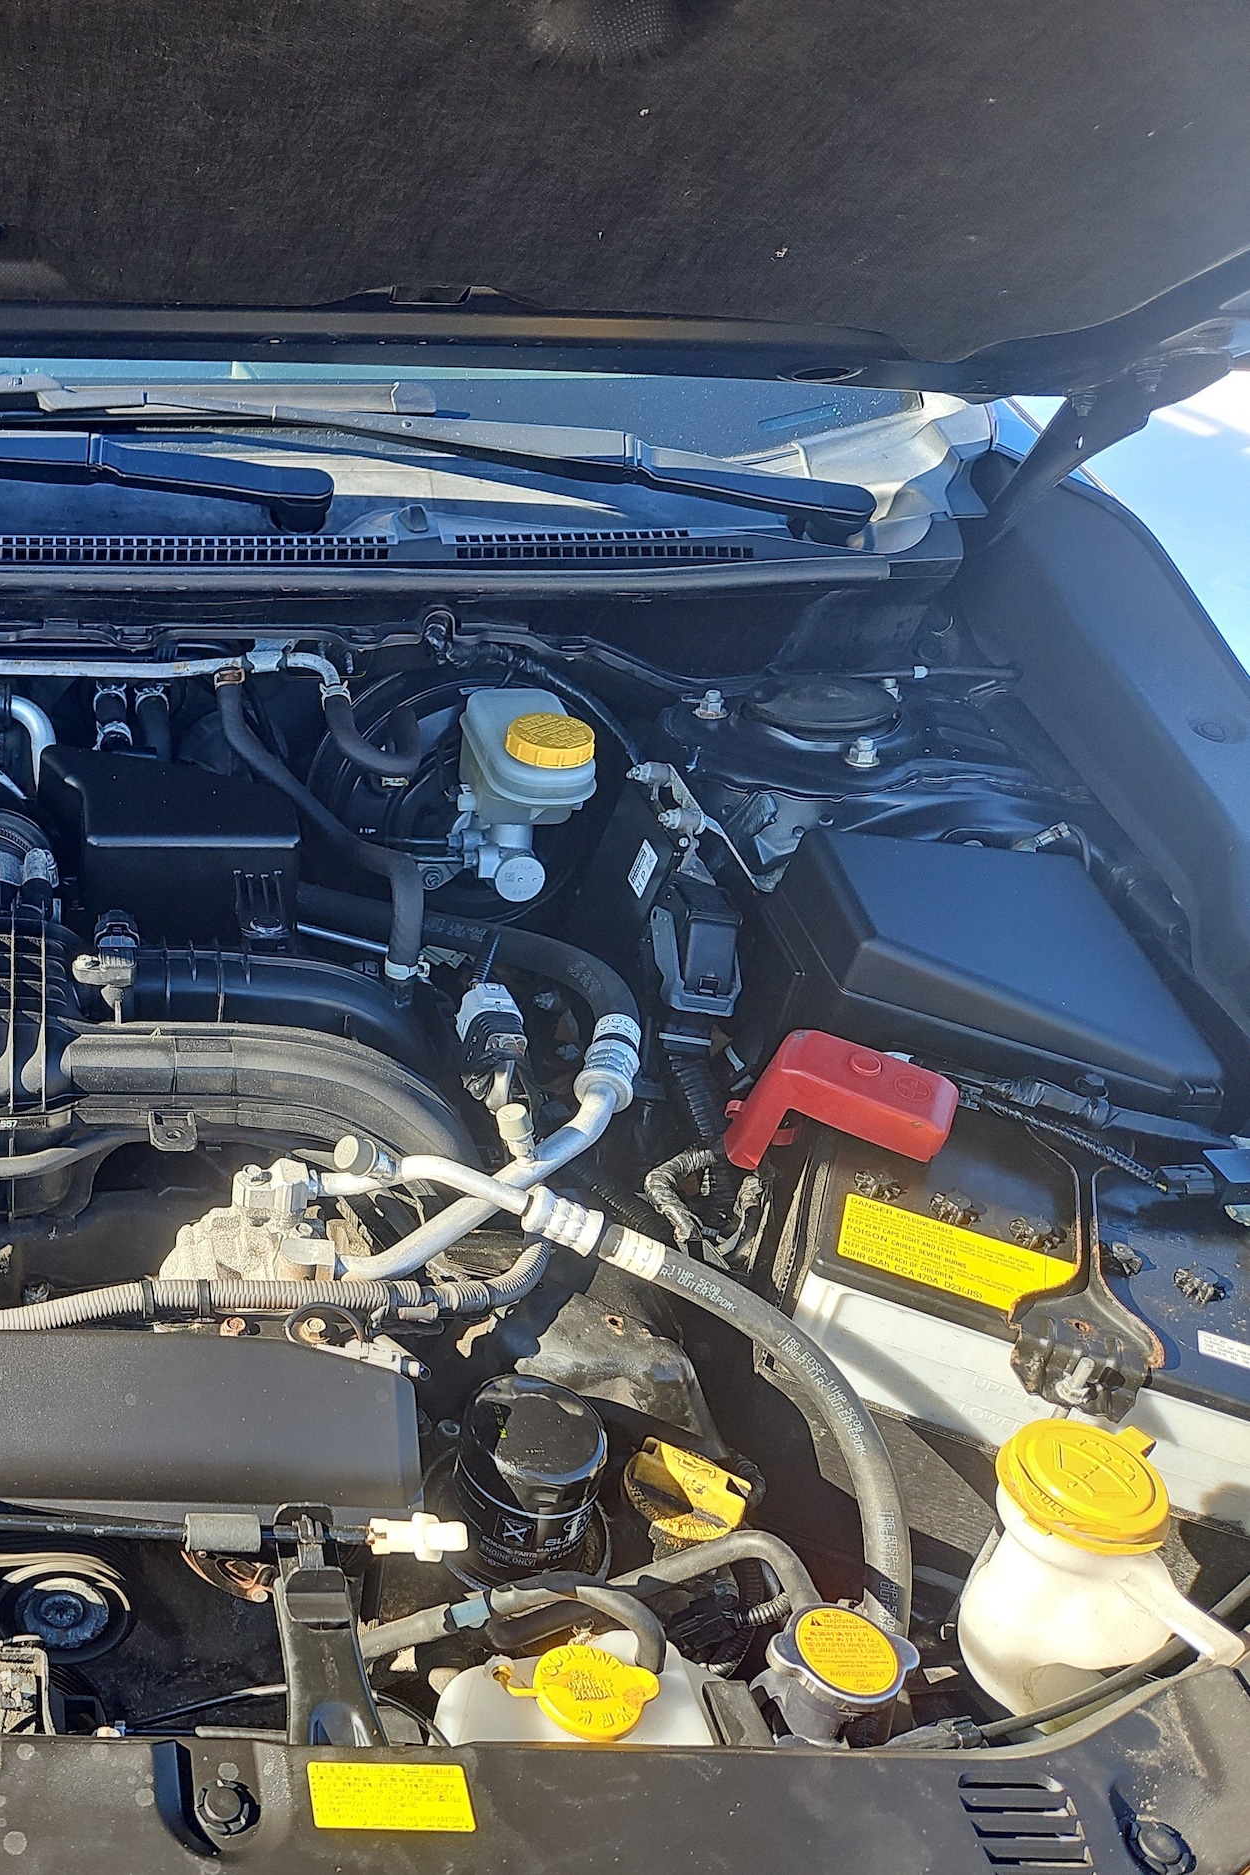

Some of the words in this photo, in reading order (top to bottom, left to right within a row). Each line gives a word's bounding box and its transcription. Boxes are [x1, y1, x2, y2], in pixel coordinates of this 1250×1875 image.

[850, 1197, 892, 1215] DANGER
[896, 1212, 929, 1227] EXPLOSIVE
[932, 1224, 953, 1234] GASES
[846, 1224, 887, 1242] POISON
[891, 1239, 916, 1251] CAUSES
[918, 1248, 941, 1260] SEVERE
[944, 1257, 966, 1268] BURNS
[847, 1216, 862, 1225] KEEP
[864, 1222, 881, 1231] VENT
[882, 1228, 899, 1237] CAPS
[901, 1234, 919, 1244] TIGHT
[921, 1241, 935, 1249] AND
[937, 1246, 957, 1256] LEVEL
[662, 1263, 695, 1279] -11HP
[842, 1247, 865, 1259] 20HR
[867, 1255, 889, 1268] 62Ah
[893, 1264, 914, 1276] CCA
[916, 1271, 939, 1284] 470A
[944, 1281, 982, 1299] D23(JIS)
[843, 1239, 859, 1249] KEEP
[860, 1245, 873, 1253] OUT
[885, 1253, 907, 1265] REACH
[919, 1265, 953, 1280] CHILDREN
[972, 1376, 1038, 1407] UPPER
[1029, 1489, 1066, 1518] PULL
[681, 1523, 723, 1538] MANUAL
[481, 1535, 512, 1553] GENUINE
[514, 1550, 538, 1558] PARTS
[541, 1648, 625, 1677] COOLANT
[570, 1670, 593, 1680] SEE
[572, 1688, 619, 1701] MANUAL
